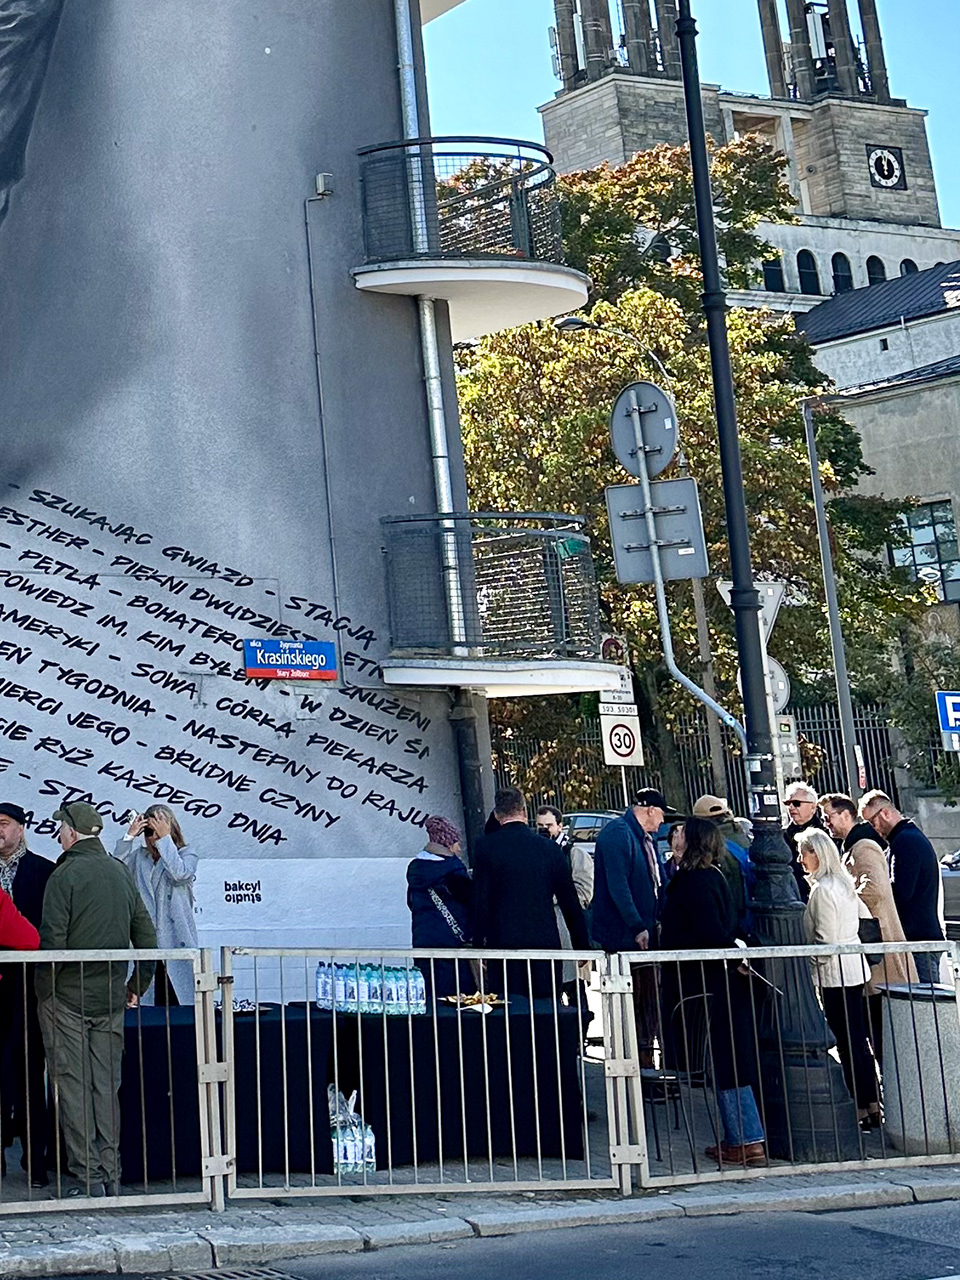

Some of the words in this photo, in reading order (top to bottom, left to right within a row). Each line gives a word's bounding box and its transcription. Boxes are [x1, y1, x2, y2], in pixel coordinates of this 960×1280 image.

[18, 549, 100, 590] PĘTLA
[28, 489, 154, 545] SZUKAJĄC
[161, 546, 254, 587] GWIAZD
[284, 596, 377, 651] STACJA
[136, 630, 186, 657] KIM
[300, 695, 322, 714] W
[328, 707, 398, 745] DZIEŃ
[256, 648, 326, 669] Krasińskiego
[38, 659, 156, 717] TYGODNIA
[326, 776, 358, 799] DO
[361, 790, 429, 828] RAJU
[67, 712, 131, 745] JEGO
[154, 745, 256, 792] BRUDNE
[259, 788, 340, 828] CZYNY
[131, 663, 198, 700] SOWA
[216, 697, 296, 738] CÓRKA
[306, 733, 429, 793] PIEKARZA
[614, 732, 631, 749] 30
[34, 736, 95, 767] RYŻ
[97, 761, 222, 818] KAŻDEGO
[227, 812, 288, 845] DNIA
[224, 880, 261, 893] bakcyl
